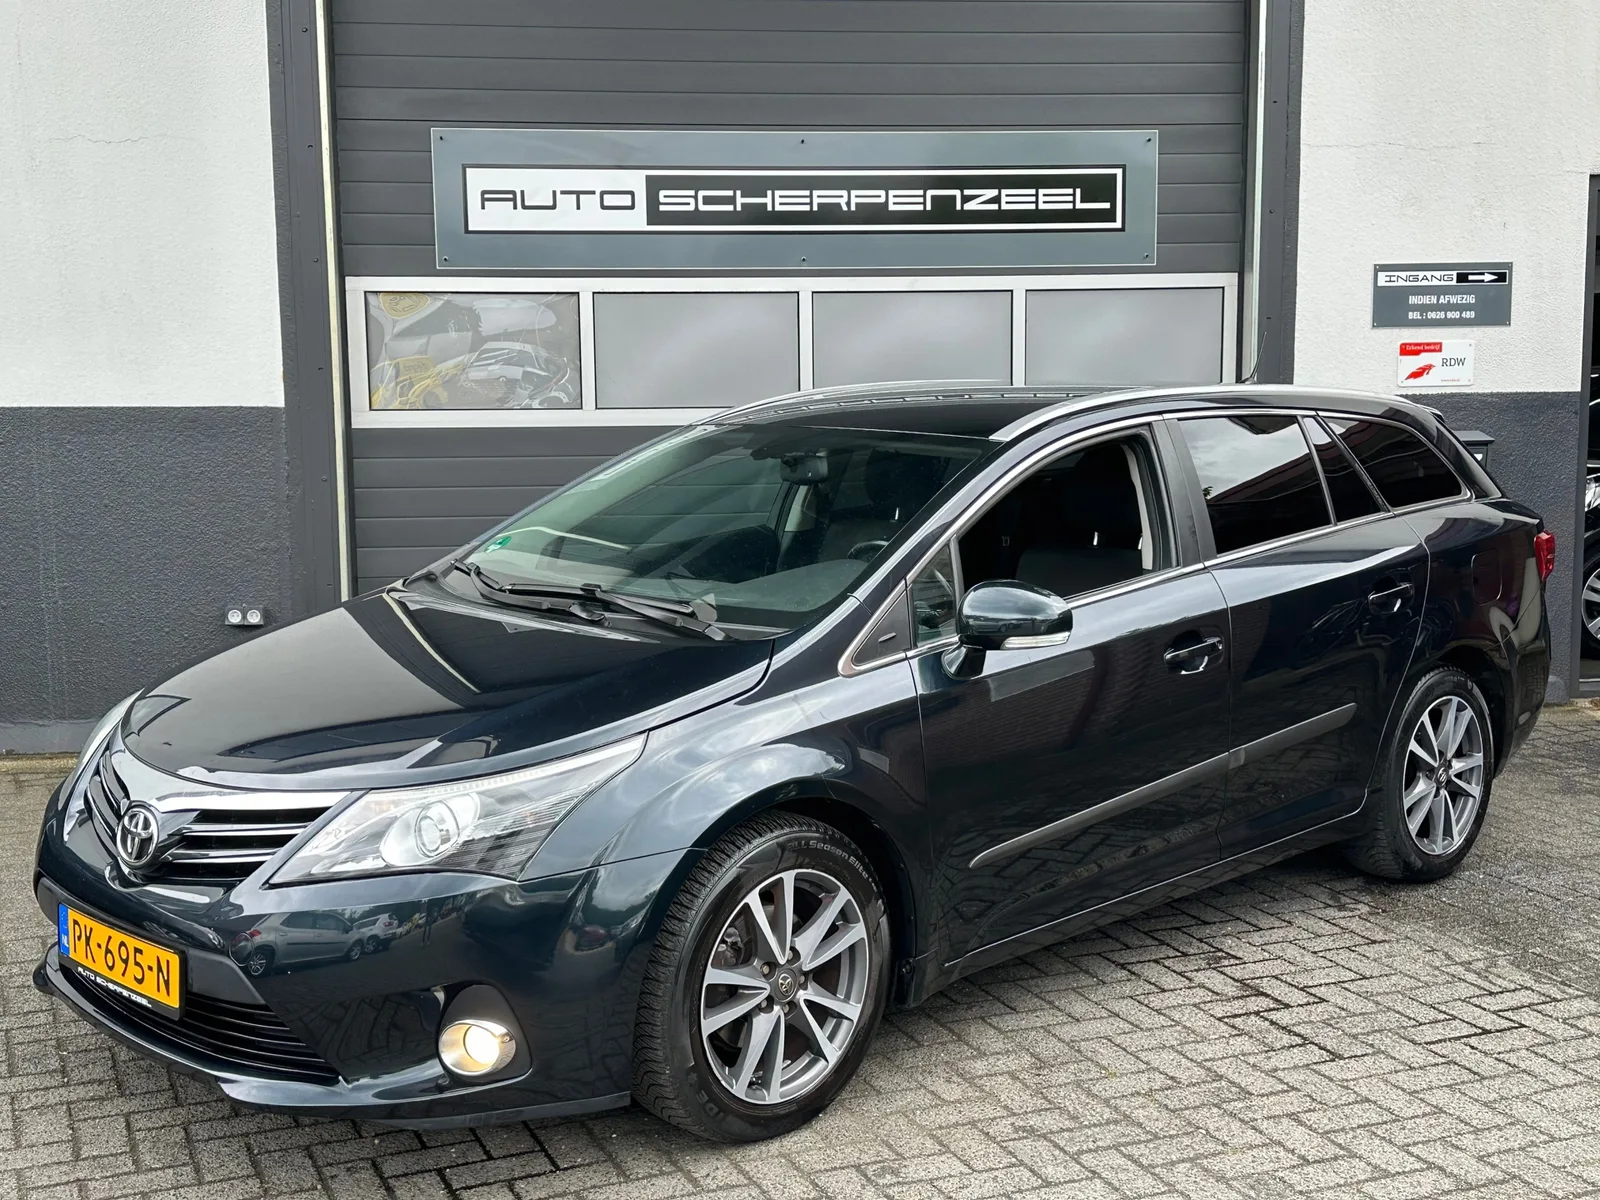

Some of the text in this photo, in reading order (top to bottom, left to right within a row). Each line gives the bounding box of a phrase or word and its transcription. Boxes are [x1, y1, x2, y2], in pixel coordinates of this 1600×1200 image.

[480, 188, 1111, 212] AUTO SCHERPENZEEL
[1384, 273, 1454, 283] INGANG
[1408, 294, 1476, 305] INDIEN AFWEZIG
[1408, 311, 1422, 320] BEL
[1441, 357, 1467, 367] RDW
[61, 933, 69, 948] NL
[72, 918, 171, 998] PK-695-N
[77, 966, 95, 981] AUTO
